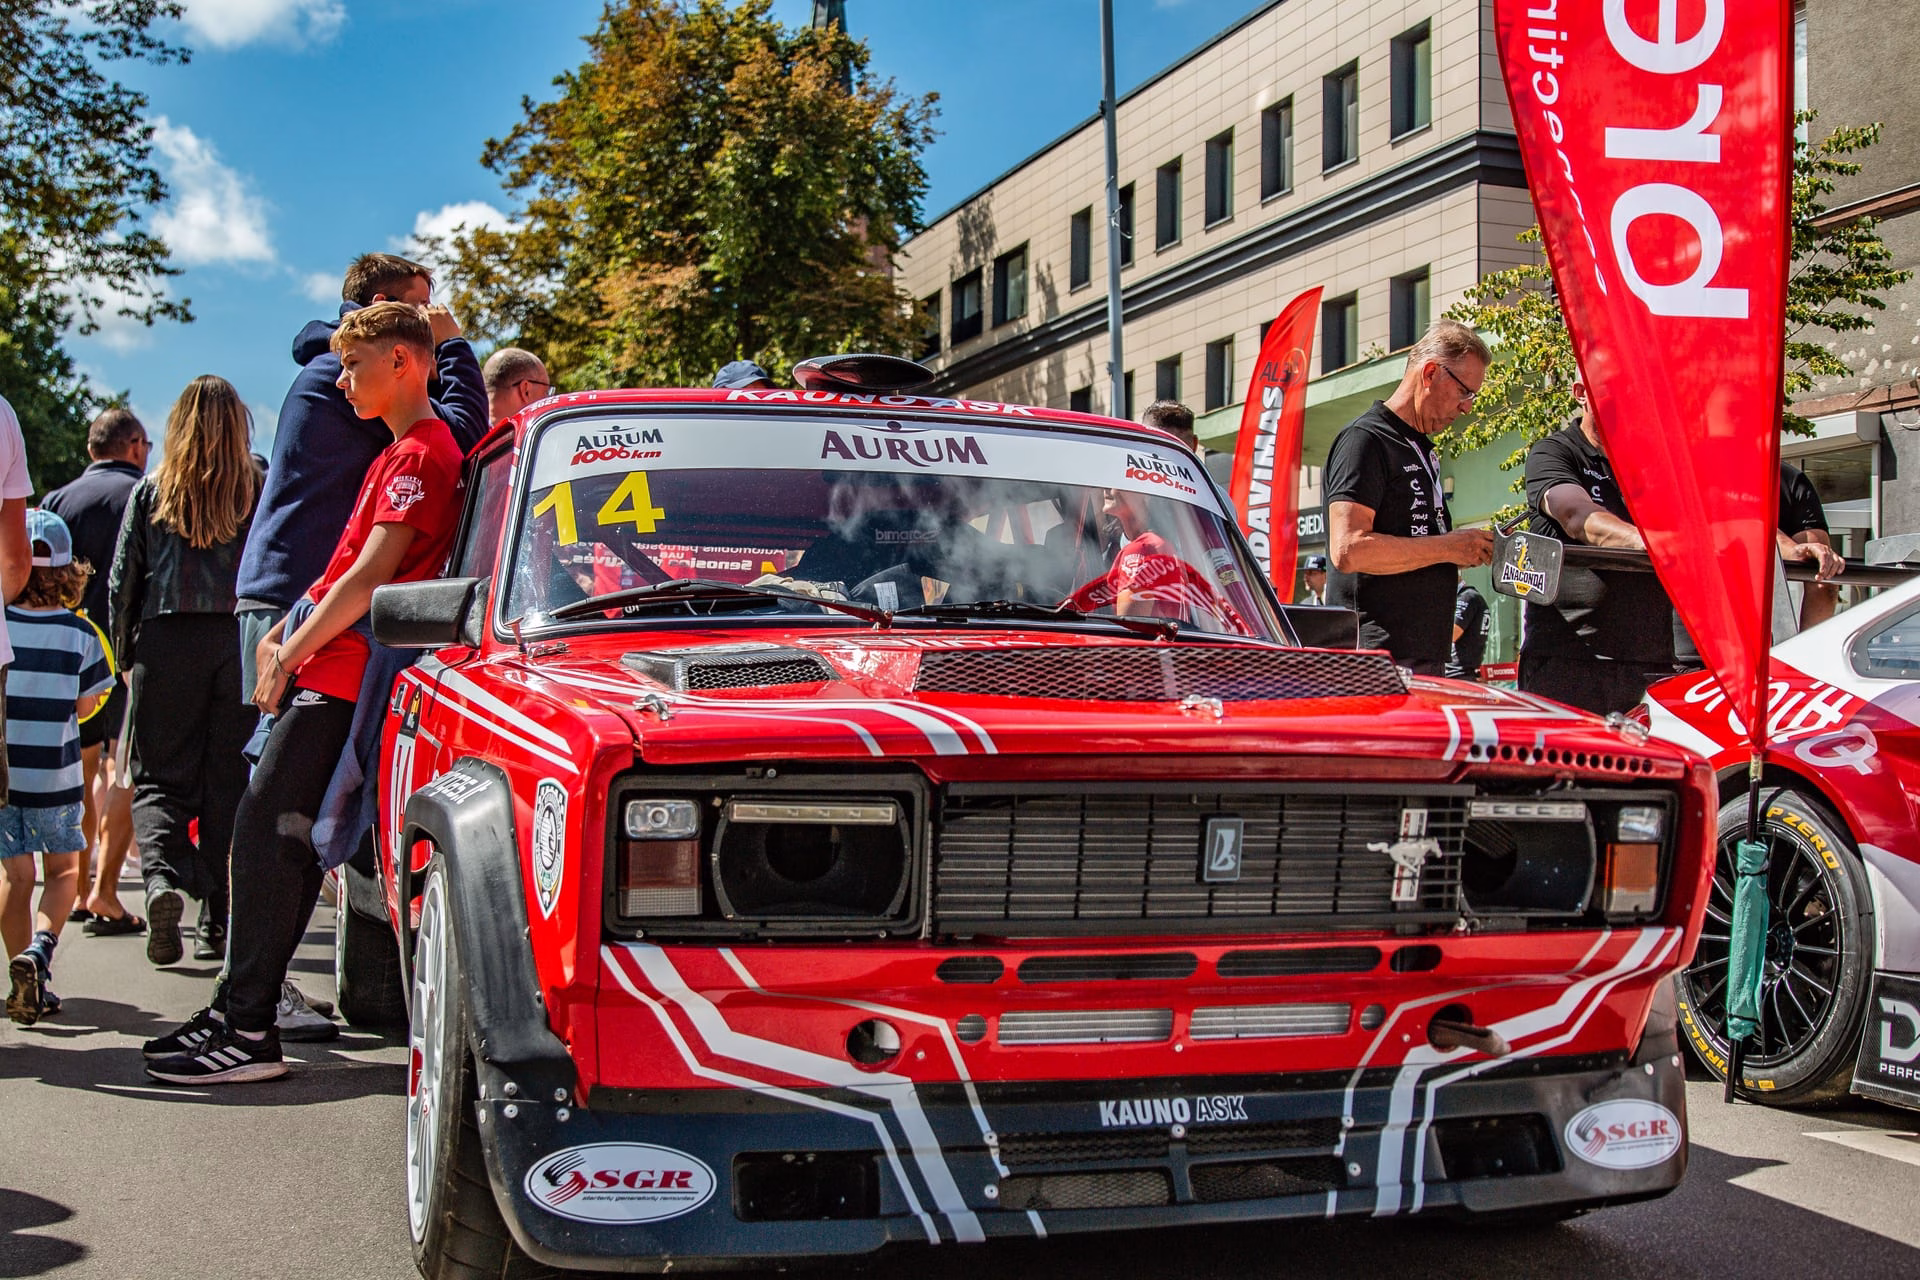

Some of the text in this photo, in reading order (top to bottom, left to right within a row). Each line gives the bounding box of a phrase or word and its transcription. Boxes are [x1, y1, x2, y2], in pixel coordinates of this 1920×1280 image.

[726, 389, 1036, 417] KAUNO ASK
[575, 428, 664, 453] AURUM
[820, 429, 989, 468] AURUM
[1126, 453, 1195, 483] AURUM
[532, 470, 666, 547] 14
[1502, 564, 1545, 592] ANACONDA
[1098, 1095, 1249, 1127] KAUNO ASK
[1606, 1119, 1670, 1141] SGR
[589, 1169, 695, 1189] SGR
